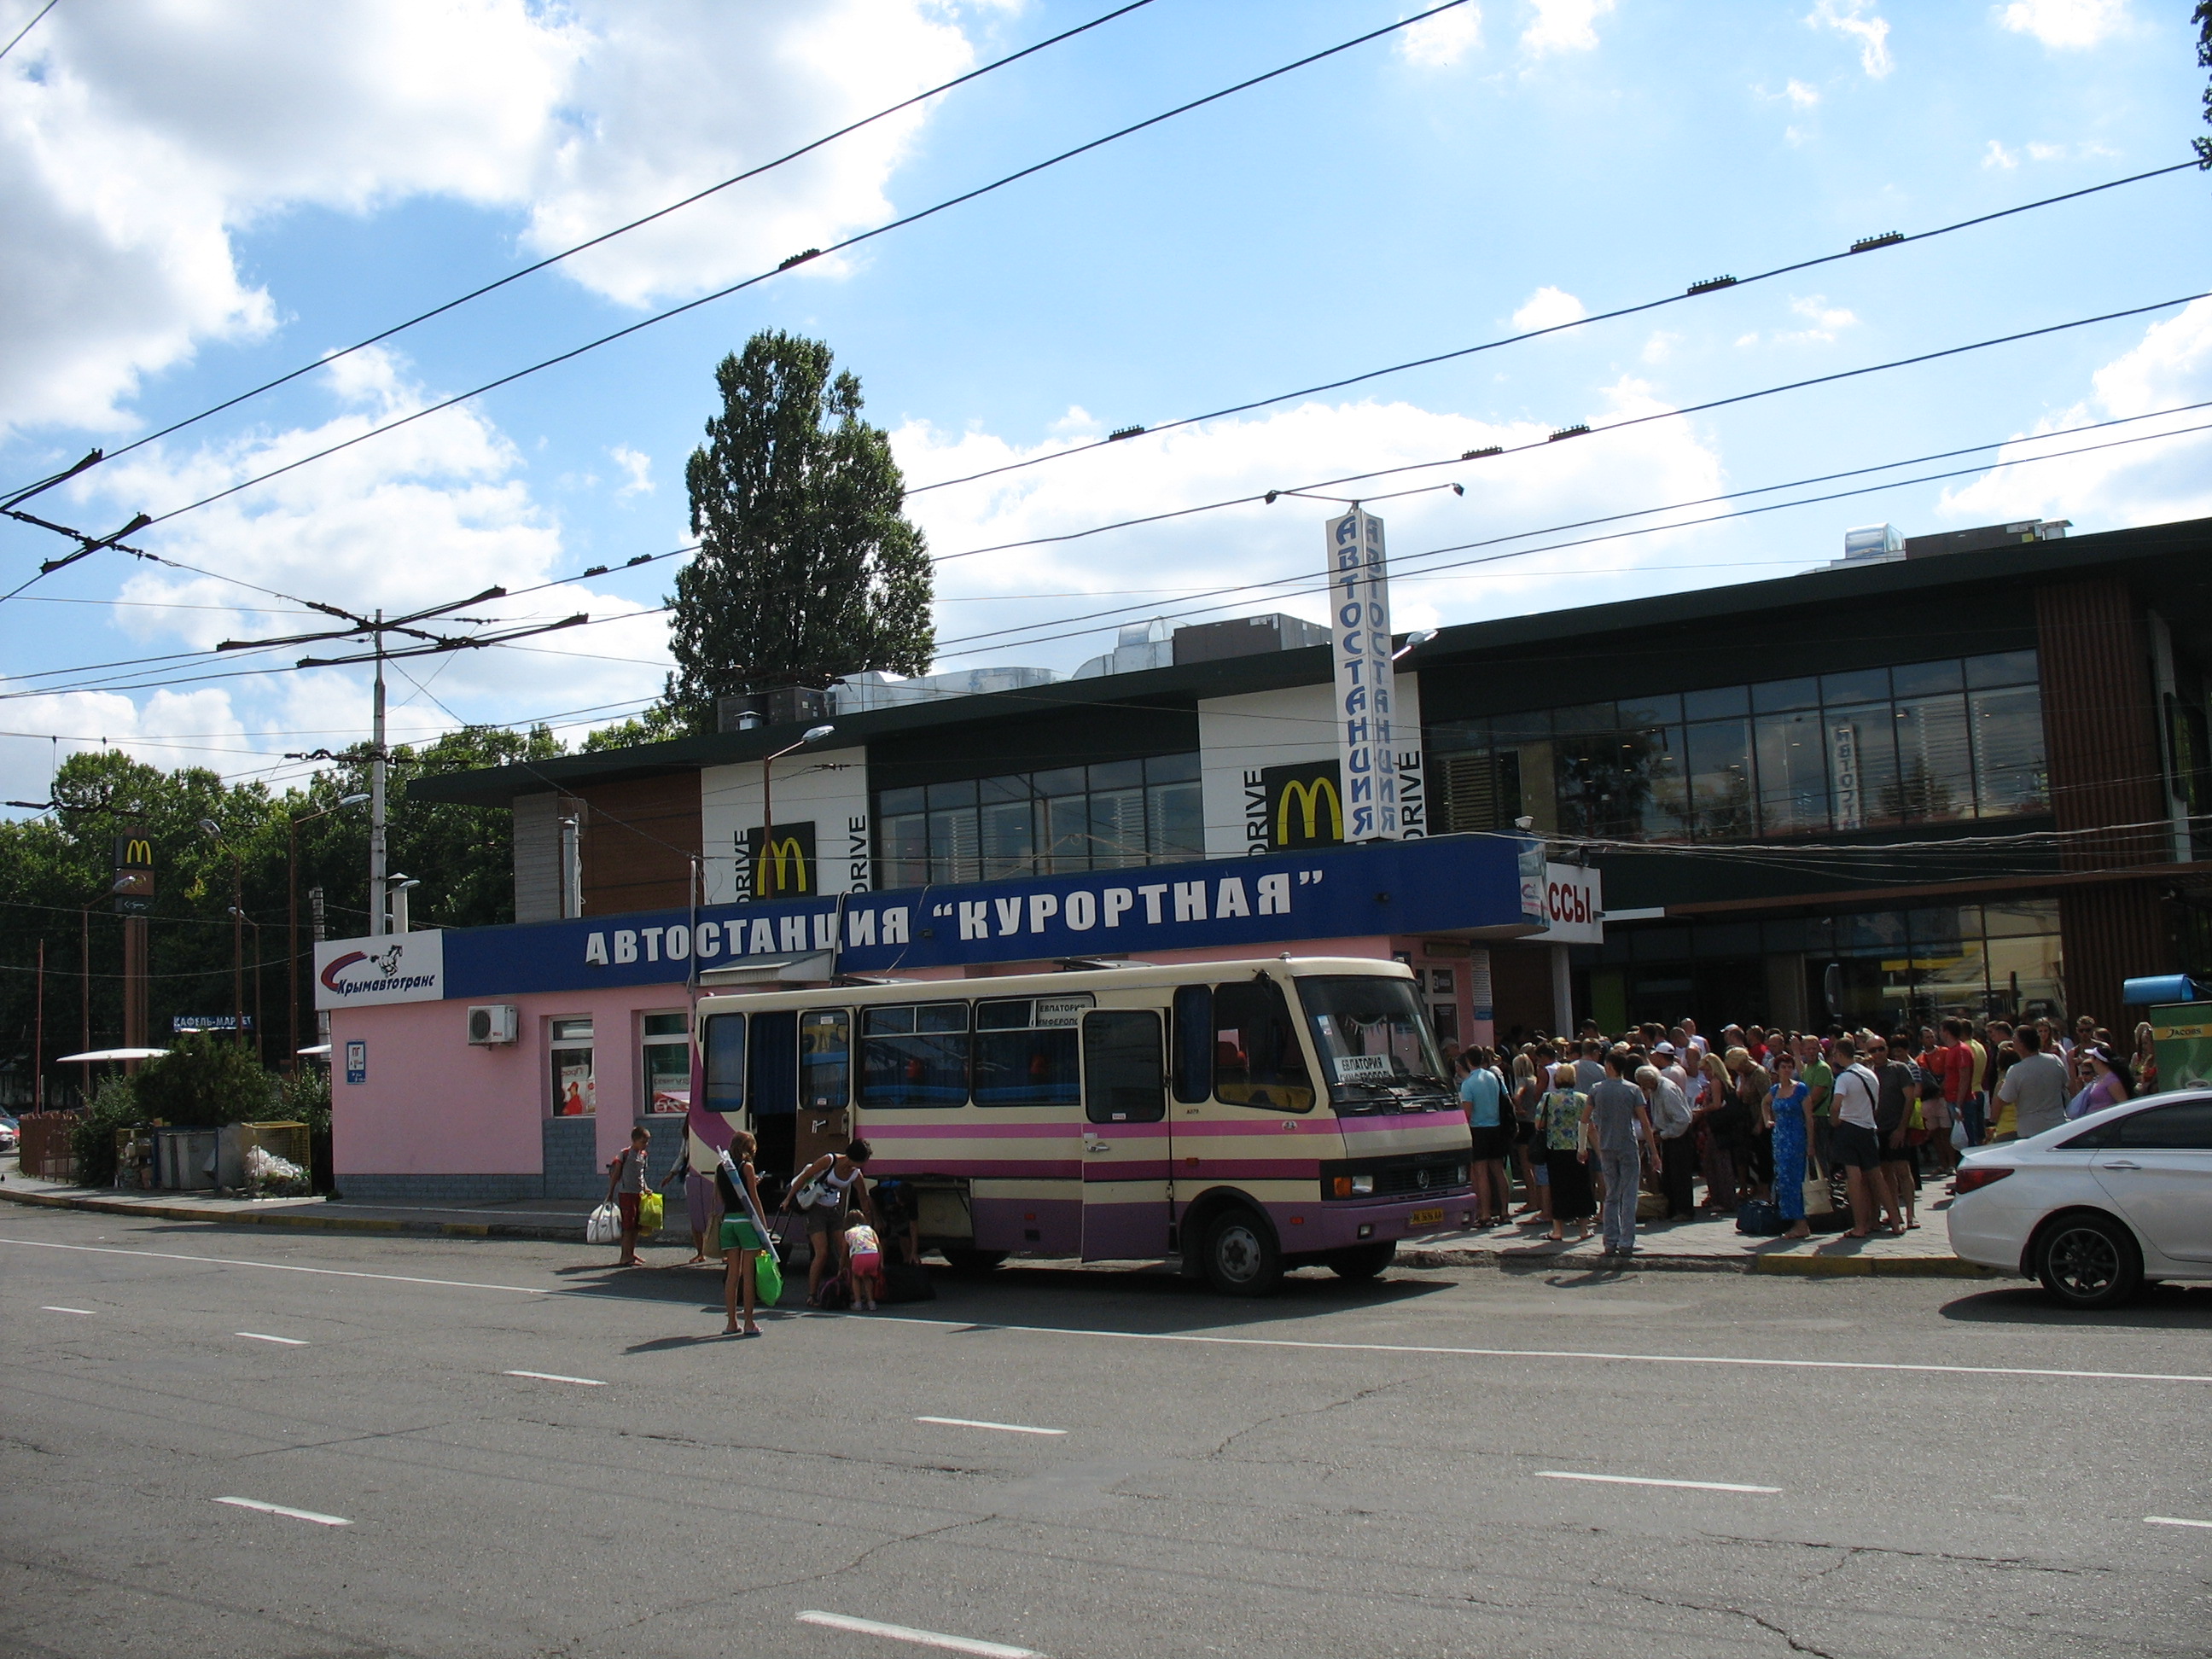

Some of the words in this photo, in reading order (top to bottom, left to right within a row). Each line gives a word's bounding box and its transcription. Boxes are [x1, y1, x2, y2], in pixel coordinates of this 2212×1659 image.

[1335, 515, 1373, 836] АВТОСТАНЦИЯ
[1365, 517, 1396, 833] АВТОСТАНЦИЯ
[585, 906, 910, 965] АВТОСТАНЦИЯ
[337, 975, 436, 998] Крымавтотранс
[173, 1015, 252, 1027] КАФЕЛЬ-МАРЕТ
[2167, 1028, 2202, 1039] JACOBS
[1342, 1057, 1383, 1071] ЕВПАТОРИЯ
